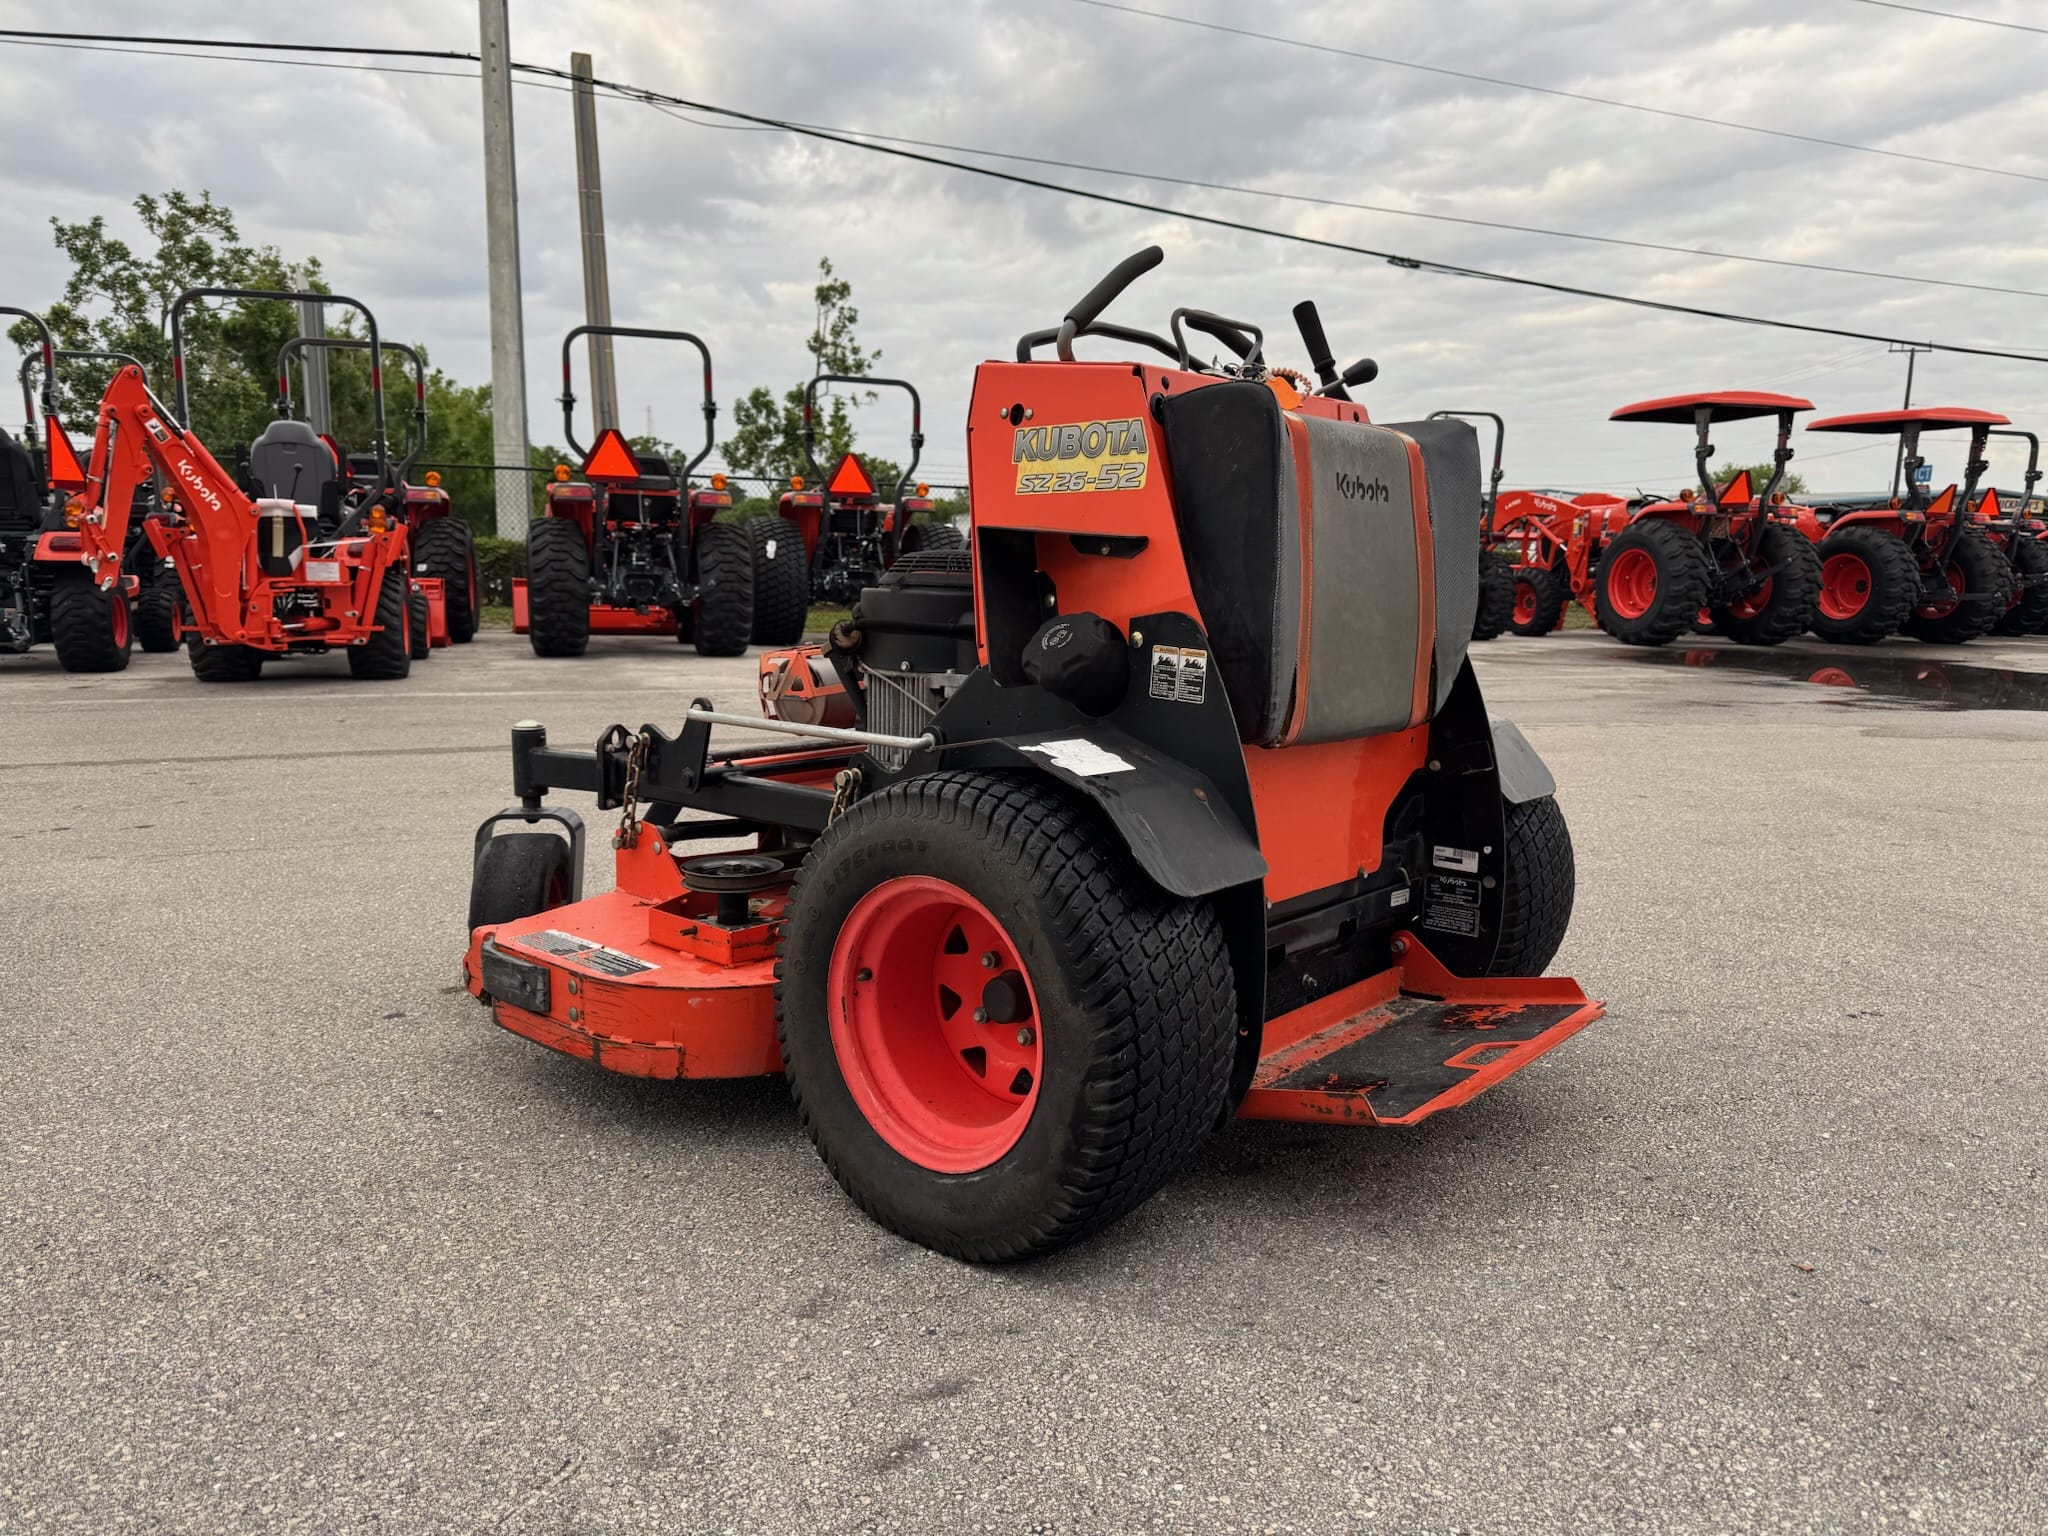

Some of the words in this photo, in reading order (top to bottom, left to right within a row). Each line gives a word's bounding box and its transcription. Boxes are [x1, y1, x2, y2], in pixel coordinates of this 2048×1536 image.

[1014, 419, 1147, 462] KUBOTA
[177, 459, 221, 511] Kubota
[1336, 472, 1389, 502] Kubota
[1534, 498, 1557, 511] Kubota
[1440, 876, 1467, 886] Kubota
